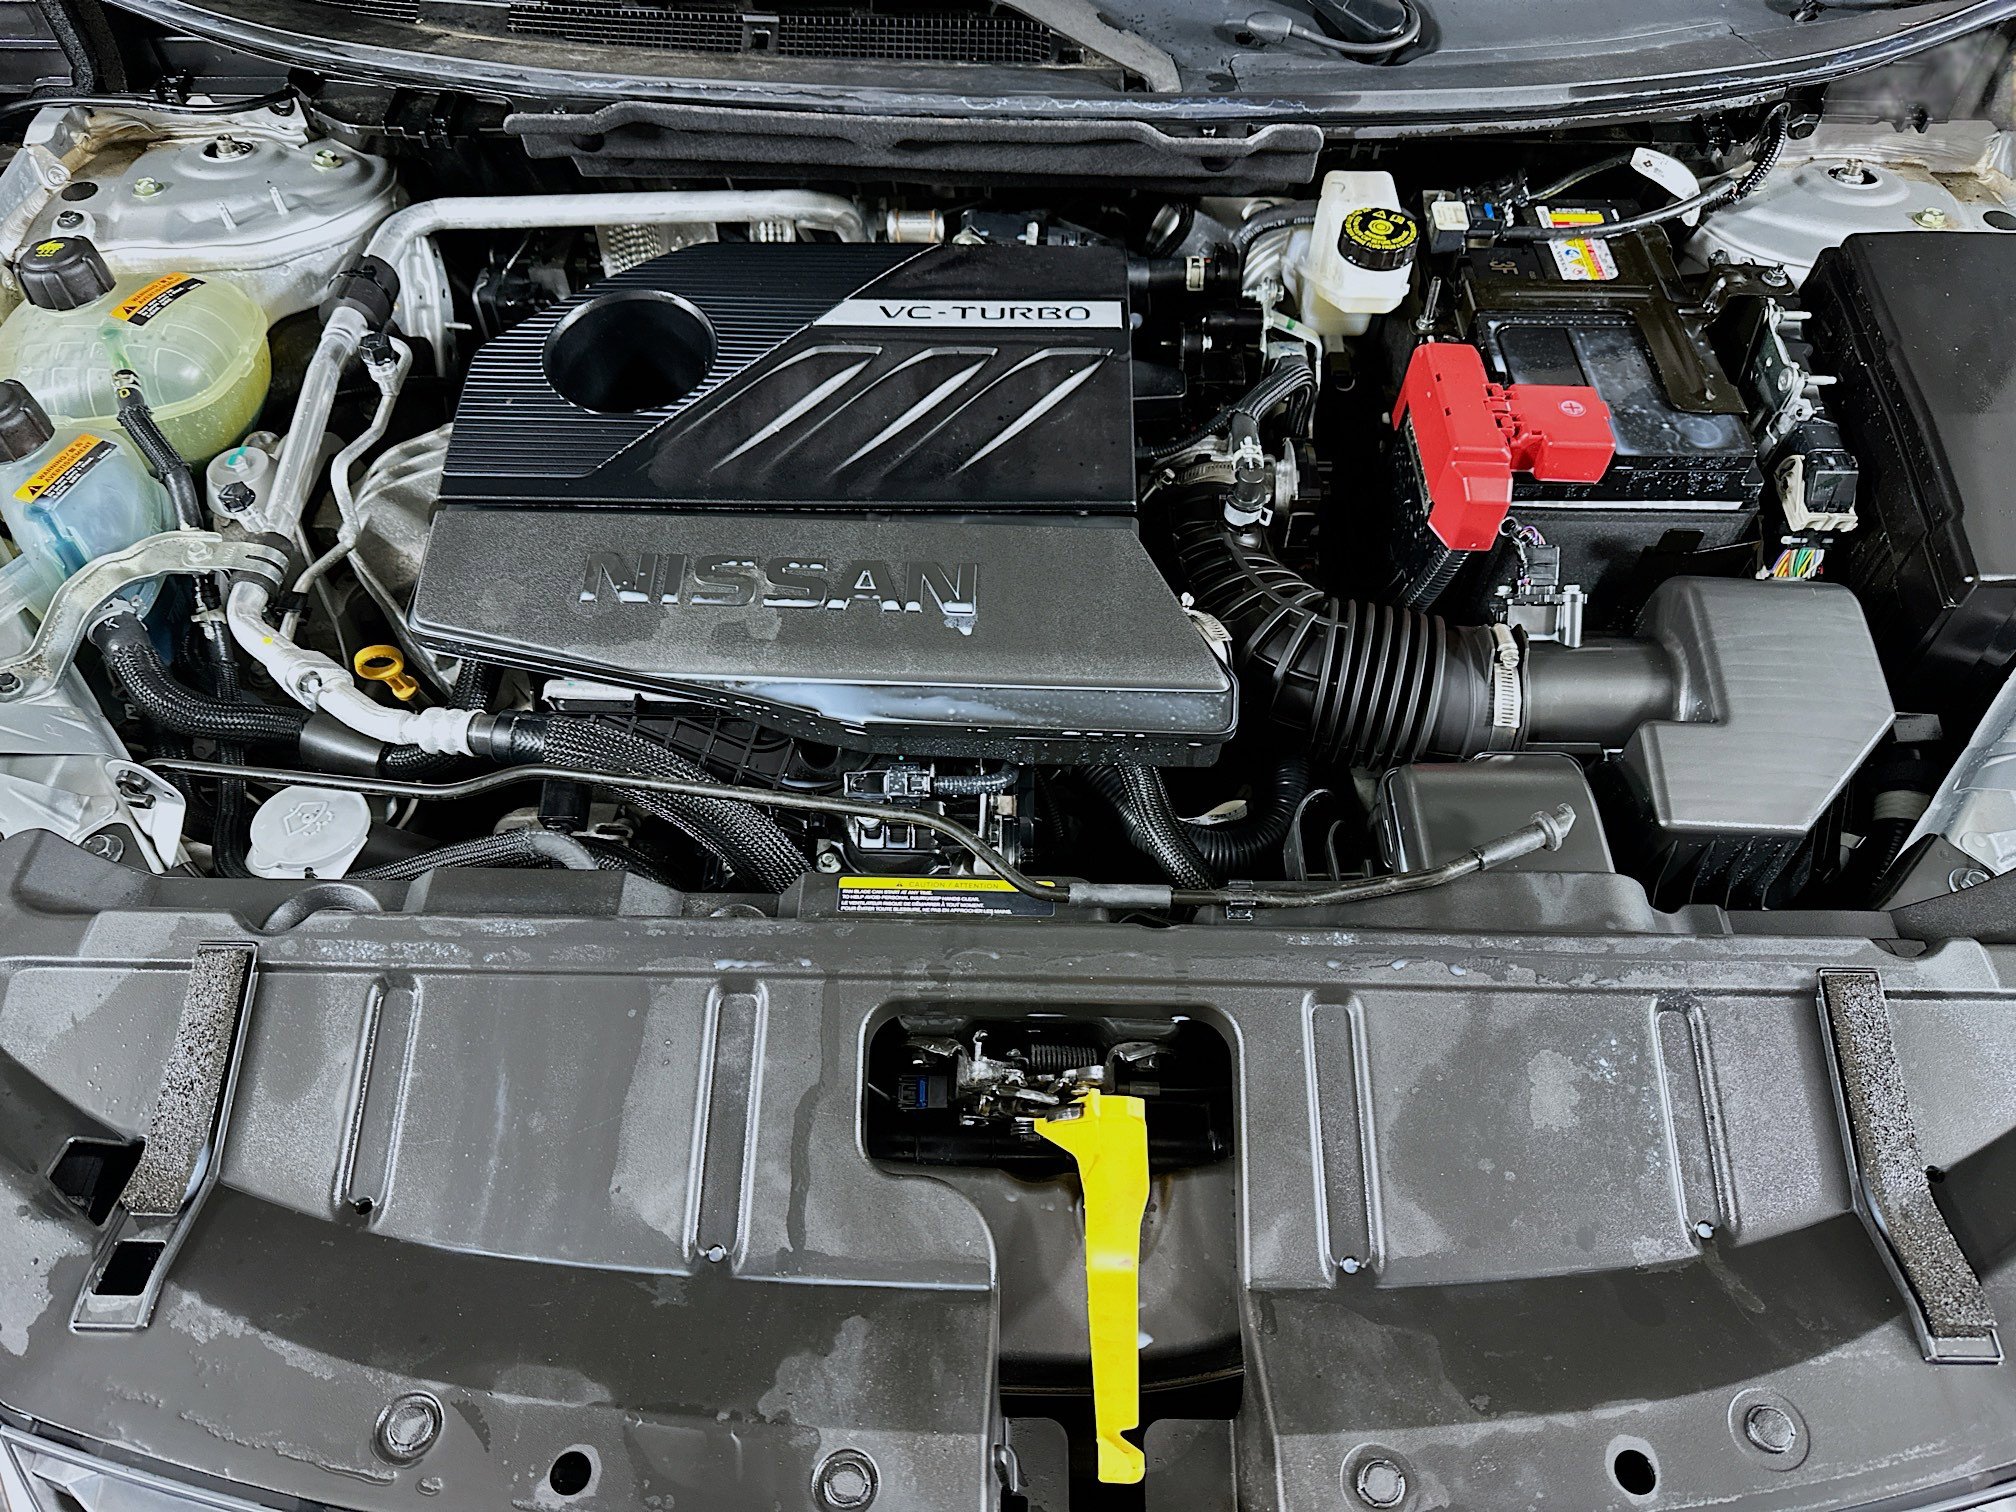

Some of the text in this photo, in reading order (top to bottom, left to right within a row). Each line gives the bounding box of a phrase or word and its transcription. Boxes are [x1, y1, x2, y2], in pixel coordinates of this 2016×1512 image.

[878, 305, 1091, 321] VC-TURBO
[37, 455, 67, 481] WARNING
[45, 441, 93, 483] AVERTISSEMENT
[578, 551, 979, 617] NISSAN
